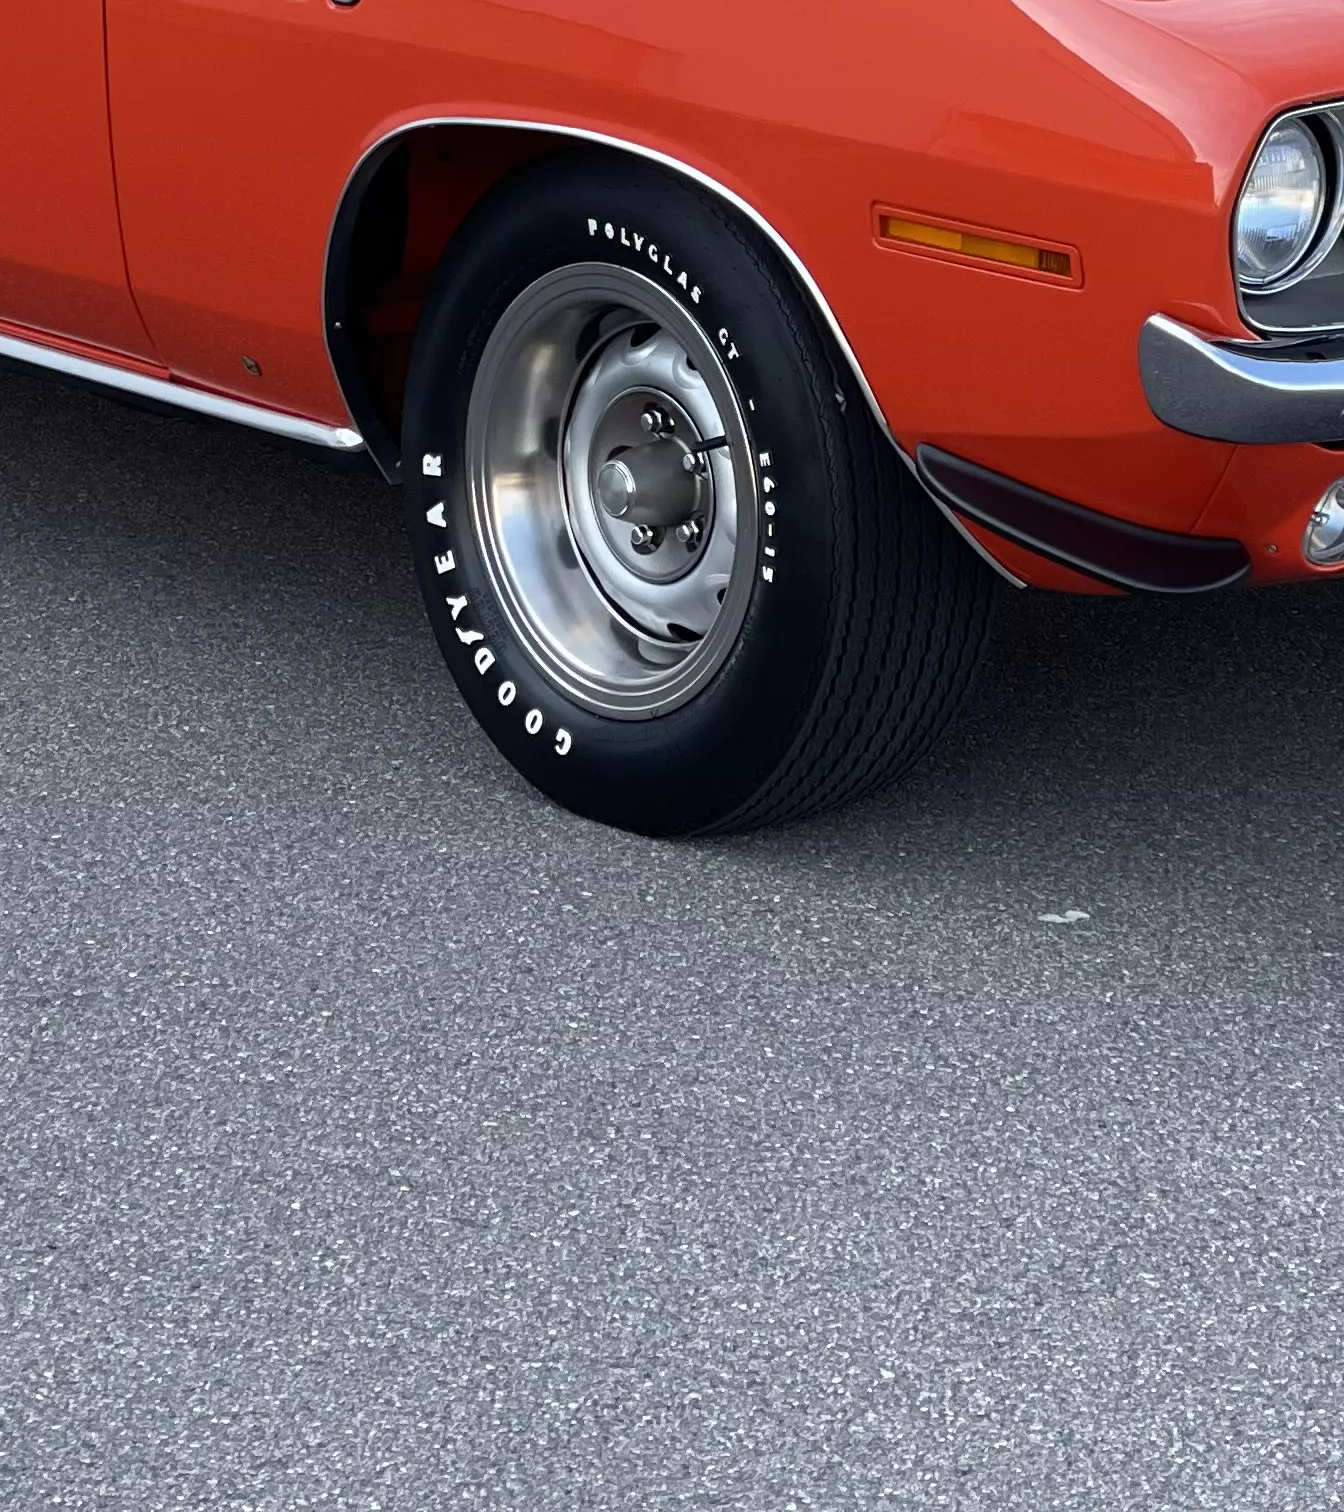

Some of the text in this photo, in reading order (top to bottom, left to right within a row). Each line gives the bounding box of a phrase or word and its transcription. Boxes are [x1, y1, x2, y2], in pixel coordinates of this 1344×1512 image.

[587, 218, 702, 304] POLYGLAS
[718, 327, 740, 360] GT
[421, 452, 572, 756] GOODYEAR
